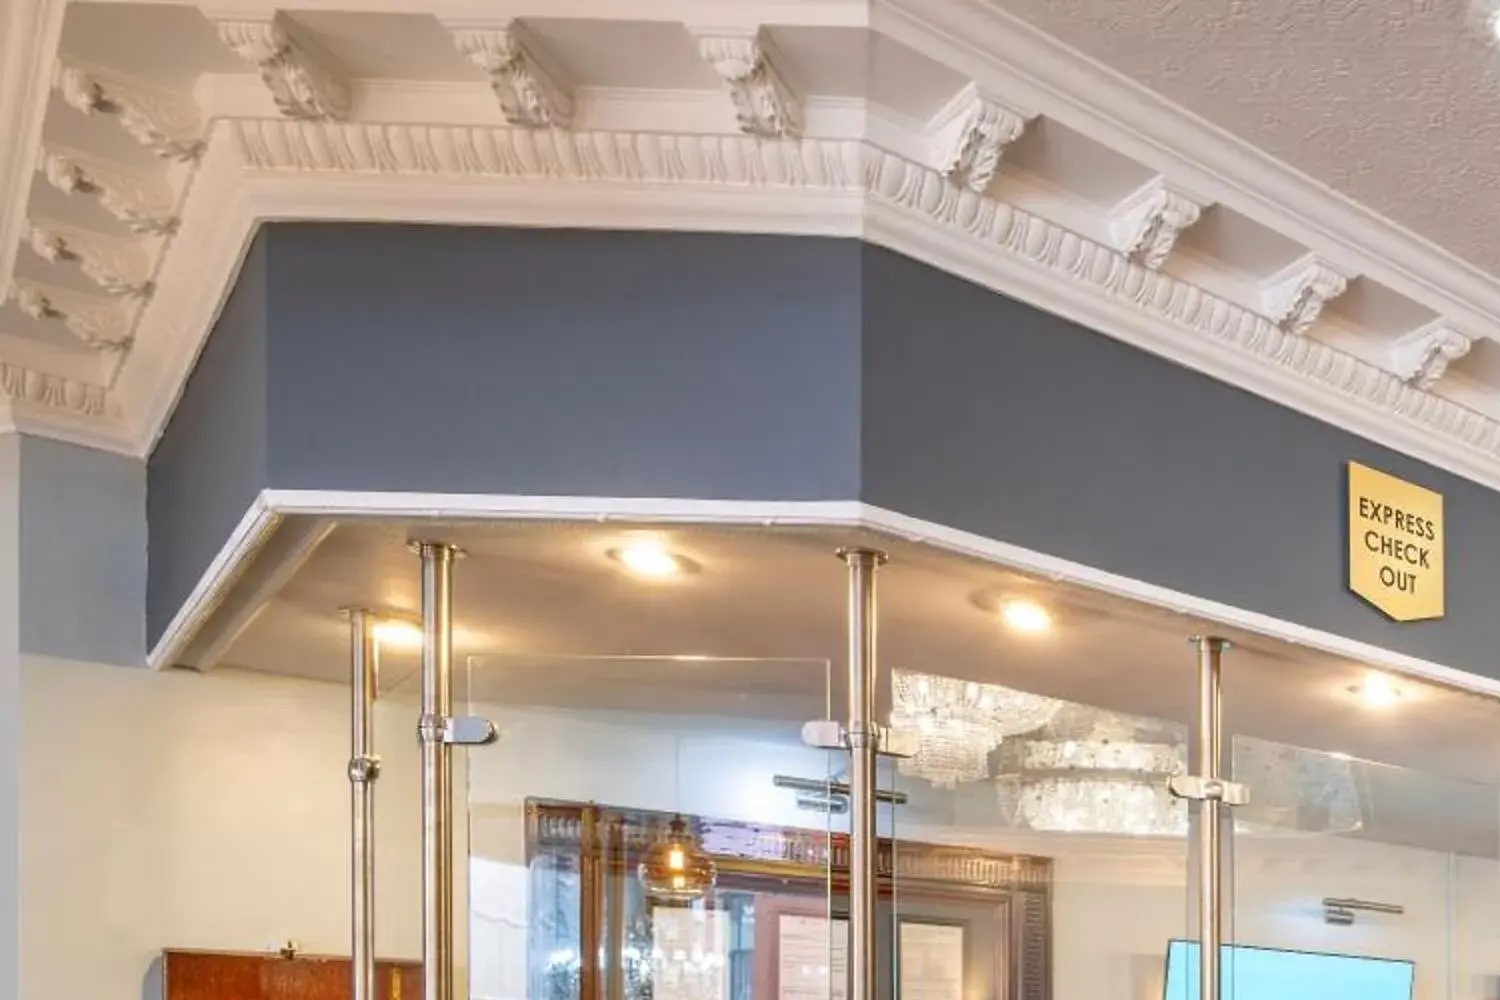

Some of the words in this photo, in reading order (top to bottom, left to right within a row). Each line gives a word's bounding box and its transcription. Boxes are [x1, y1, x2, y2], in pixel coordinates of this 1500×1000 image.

[1358, 496, 1435, 541] EXPRESS
[1364, 530, 1430, 570] CHECK
[1379, 565, 1417, 595] OUT
